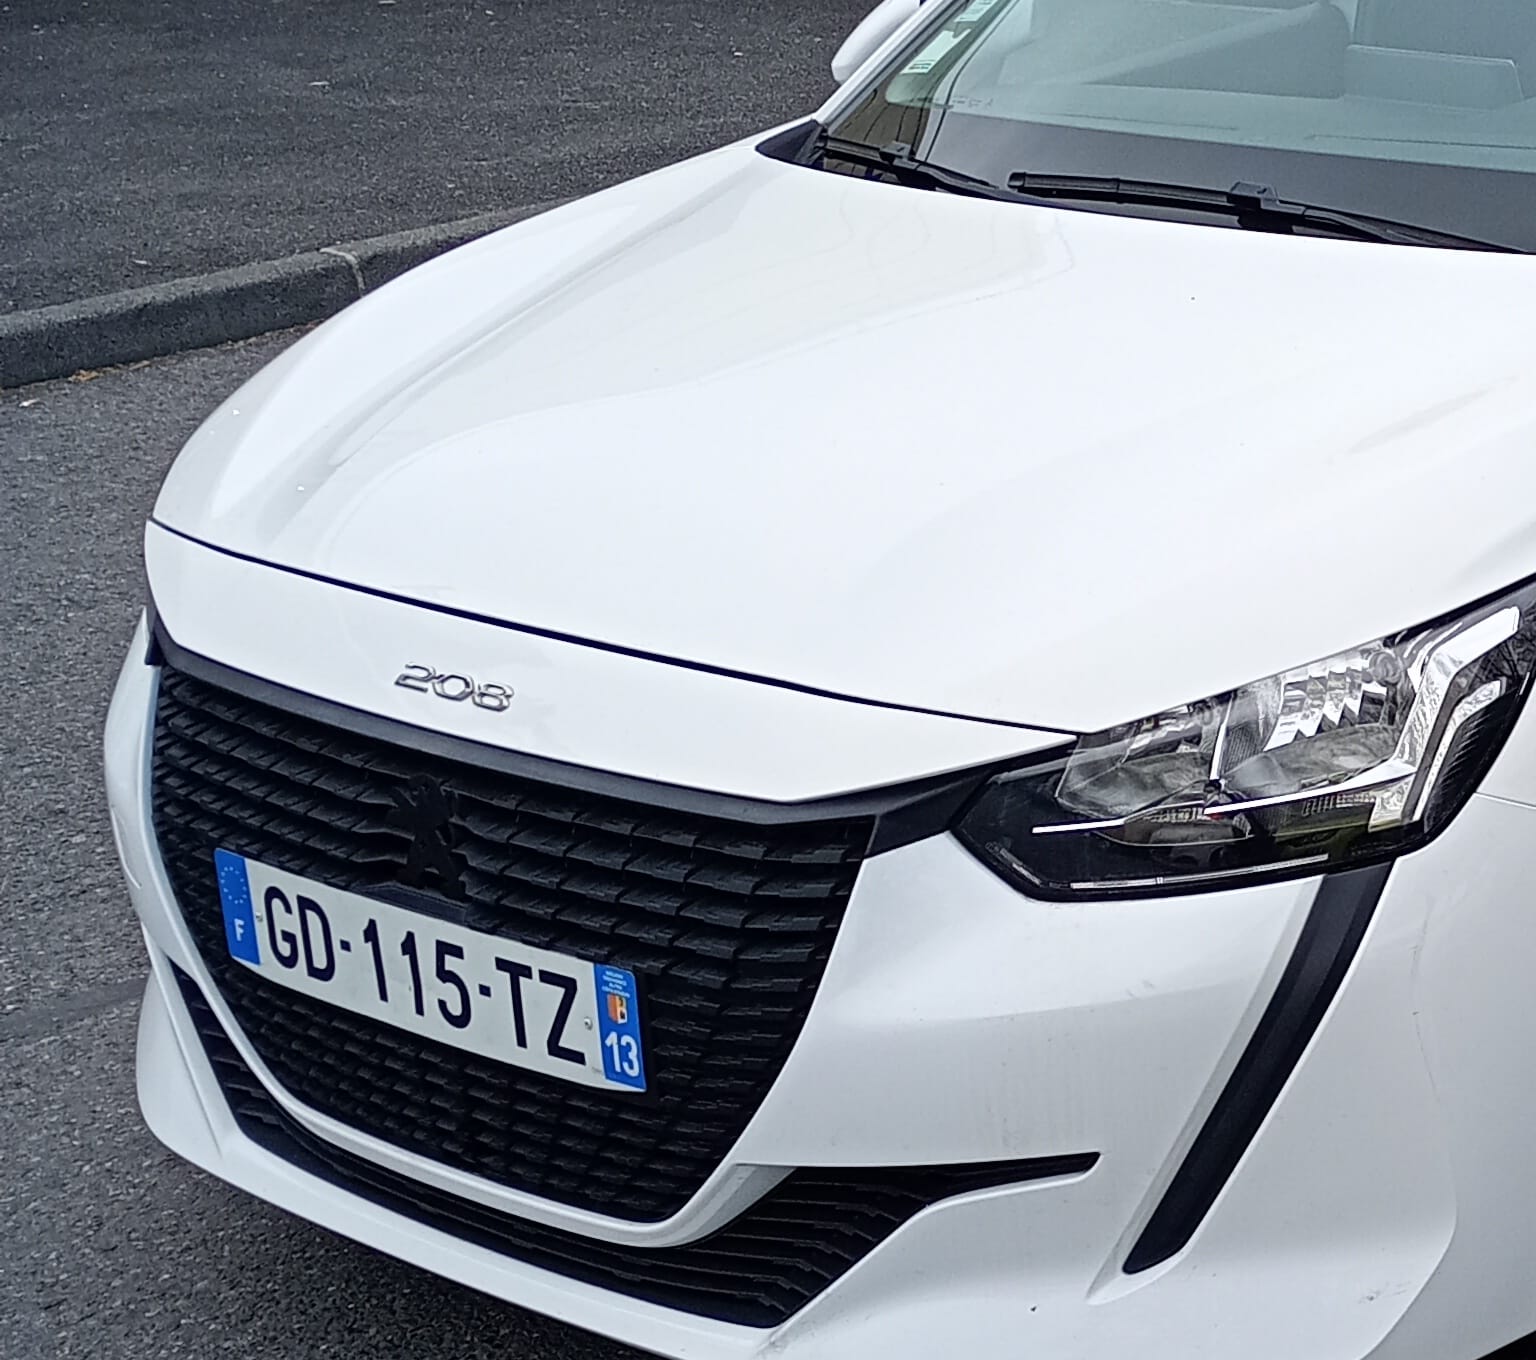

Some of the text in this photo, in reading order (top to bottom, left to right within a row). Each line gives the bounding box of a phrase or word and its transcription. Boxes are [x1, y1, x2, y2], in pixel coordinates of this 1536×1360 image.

[394, 662, 515, 713] 208
[233, 917, 245, 942] F
[263, 885, 587, 1066] GD-115-TZ
[604, 1030, 640, 1078] 13
